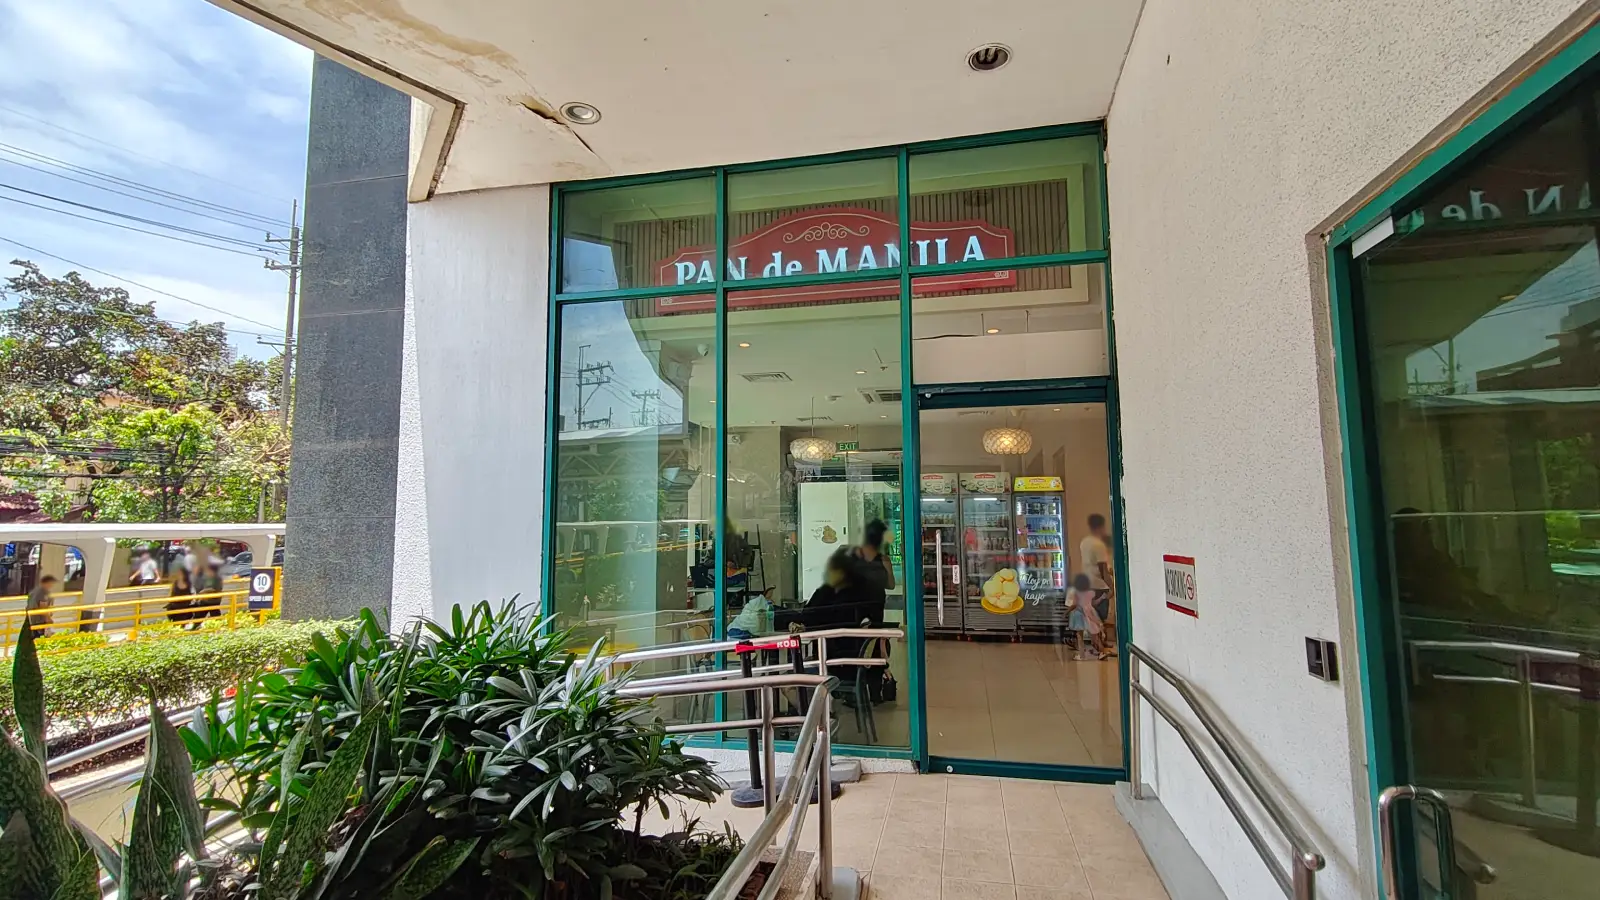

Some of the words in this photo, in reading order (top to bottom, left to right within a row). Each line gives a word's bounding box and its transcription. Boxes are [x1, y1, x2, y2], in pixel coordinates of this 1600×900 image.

[674, 256, 748, 286] PAN
[762, 250, 803, 278] de
[839, 443, 856, 451] EXIT
[257, 575, 268, 587] 10
[1024, 590, 1047, 606] kayo
